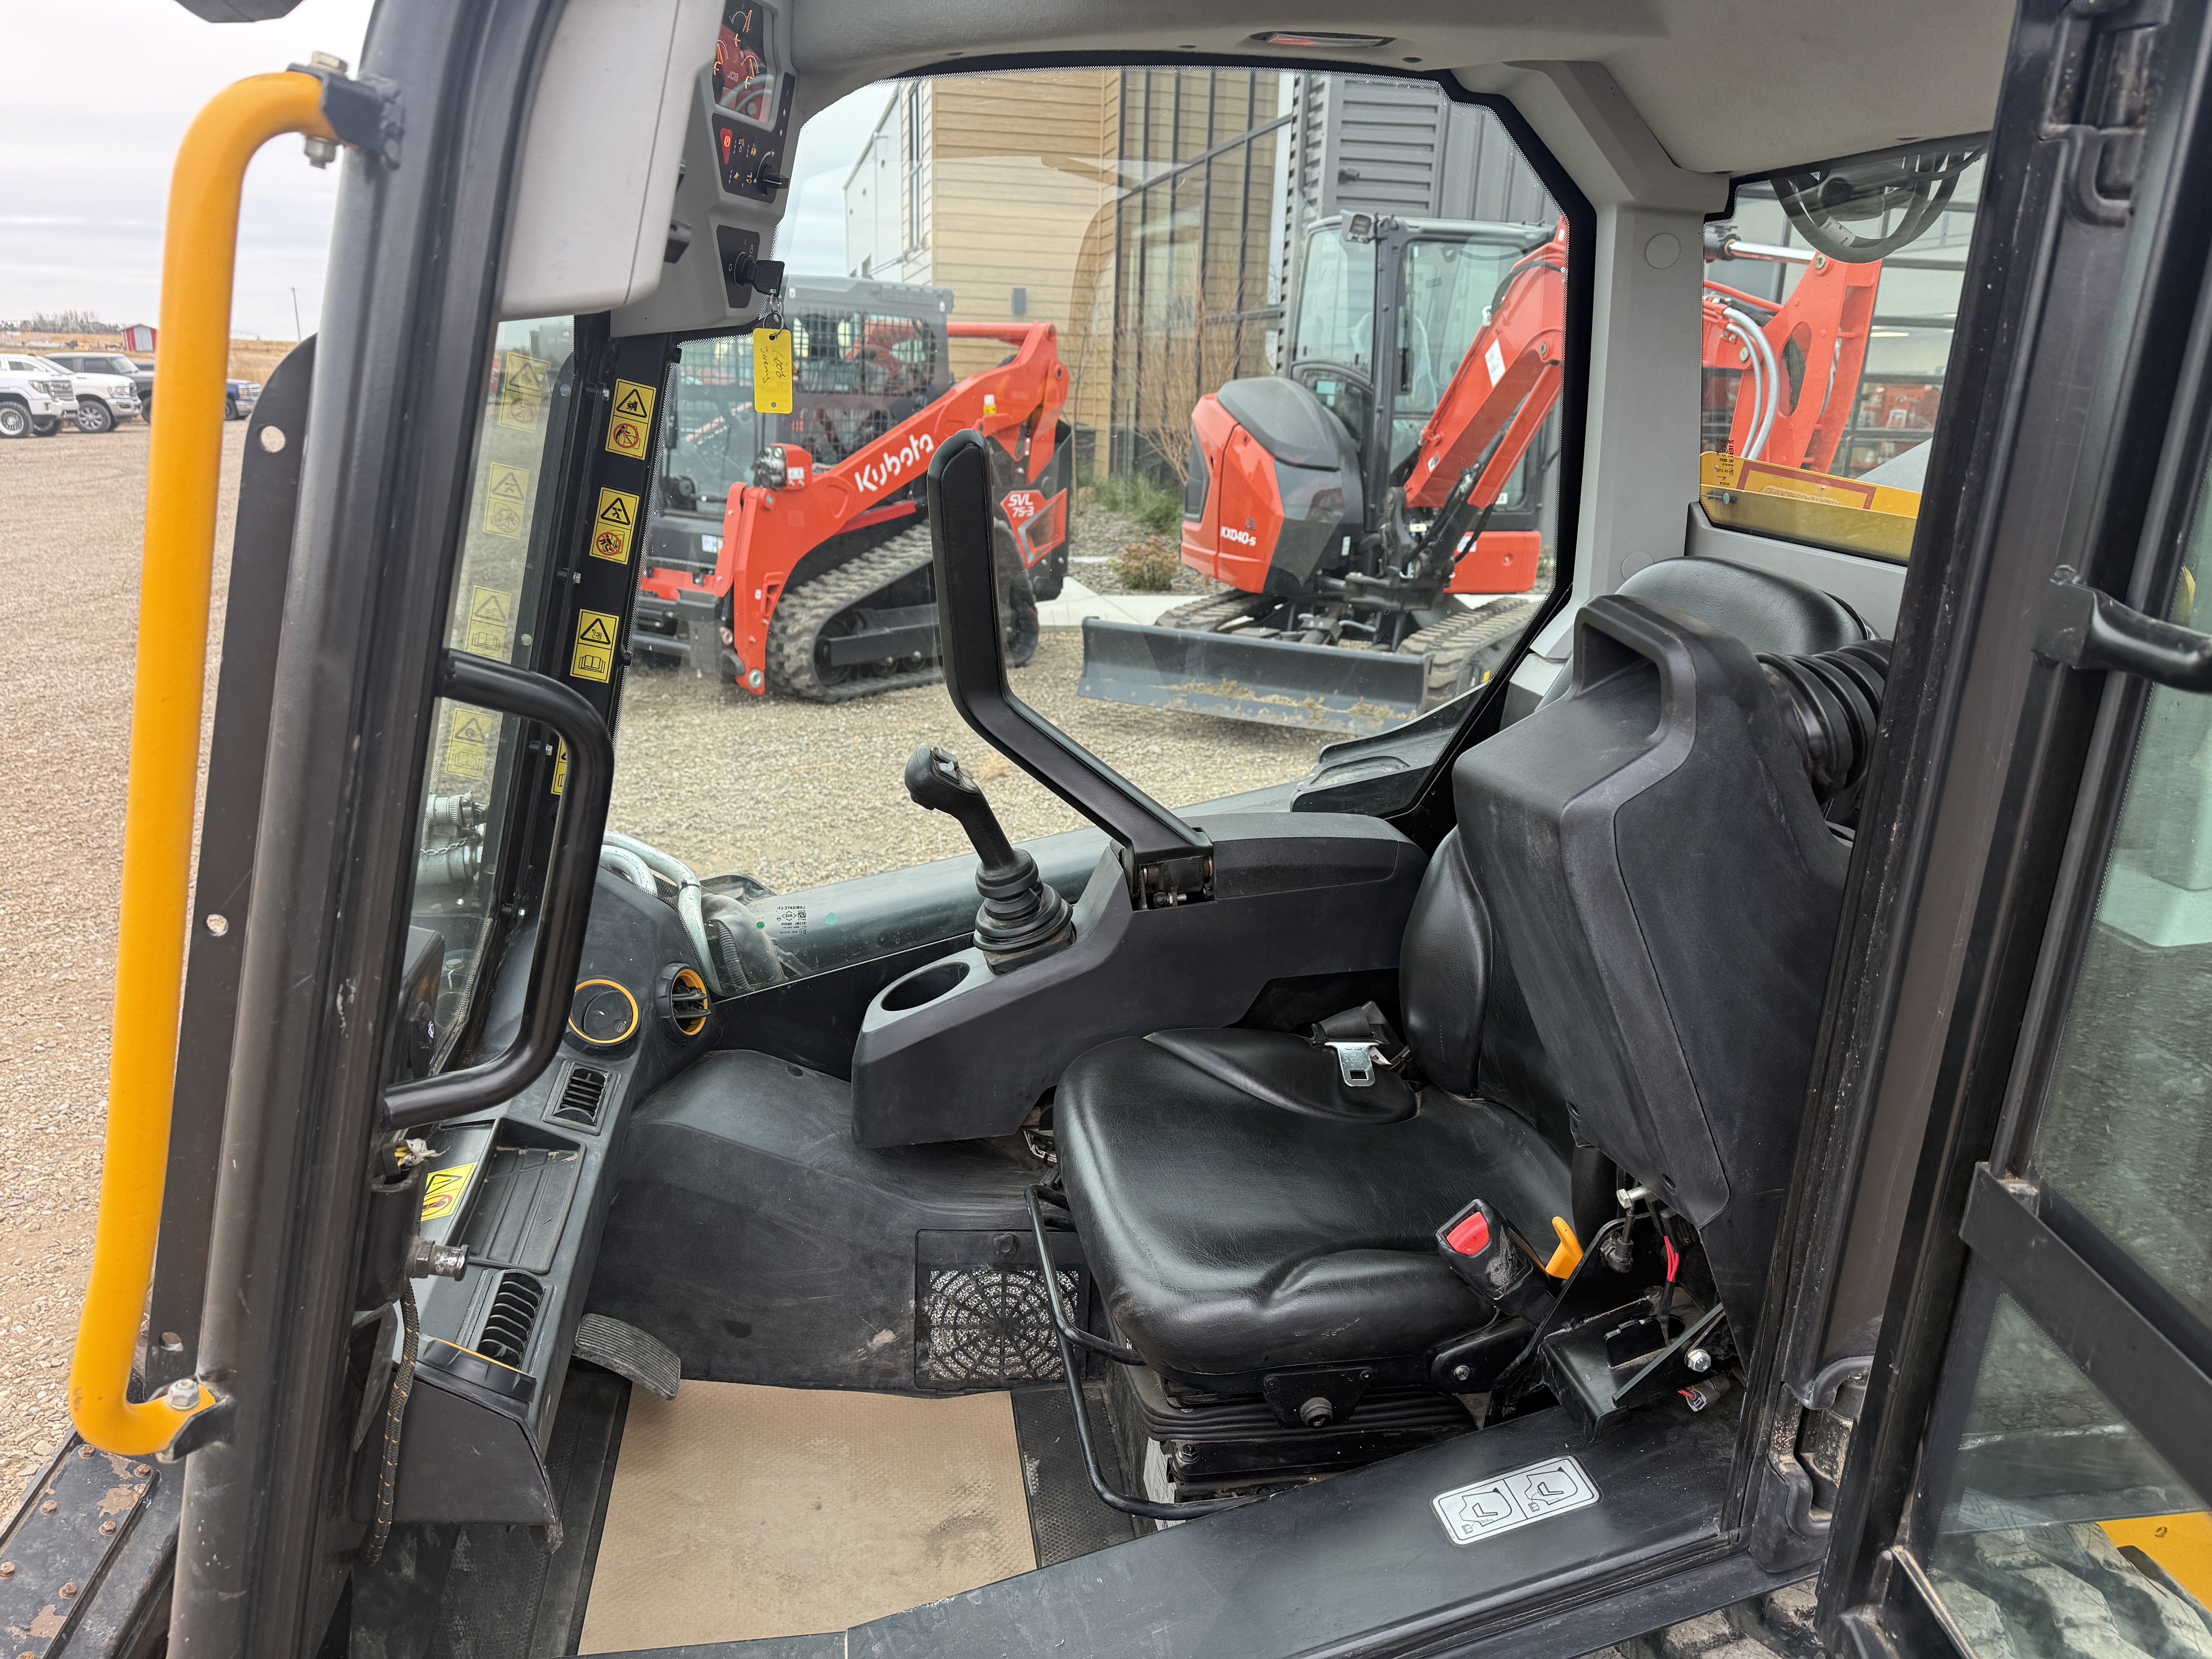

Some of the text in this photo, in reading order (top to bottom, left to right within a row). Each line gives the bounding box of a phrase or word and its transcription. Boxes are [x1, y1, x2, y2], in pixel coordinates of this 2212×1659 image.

[727, 70, 738, 82] JCB
[854, 433, 934, 493] Kubota
[1008, 493, 1033, 507] SVL
[1012, 506, 1035, 517] 75-3
